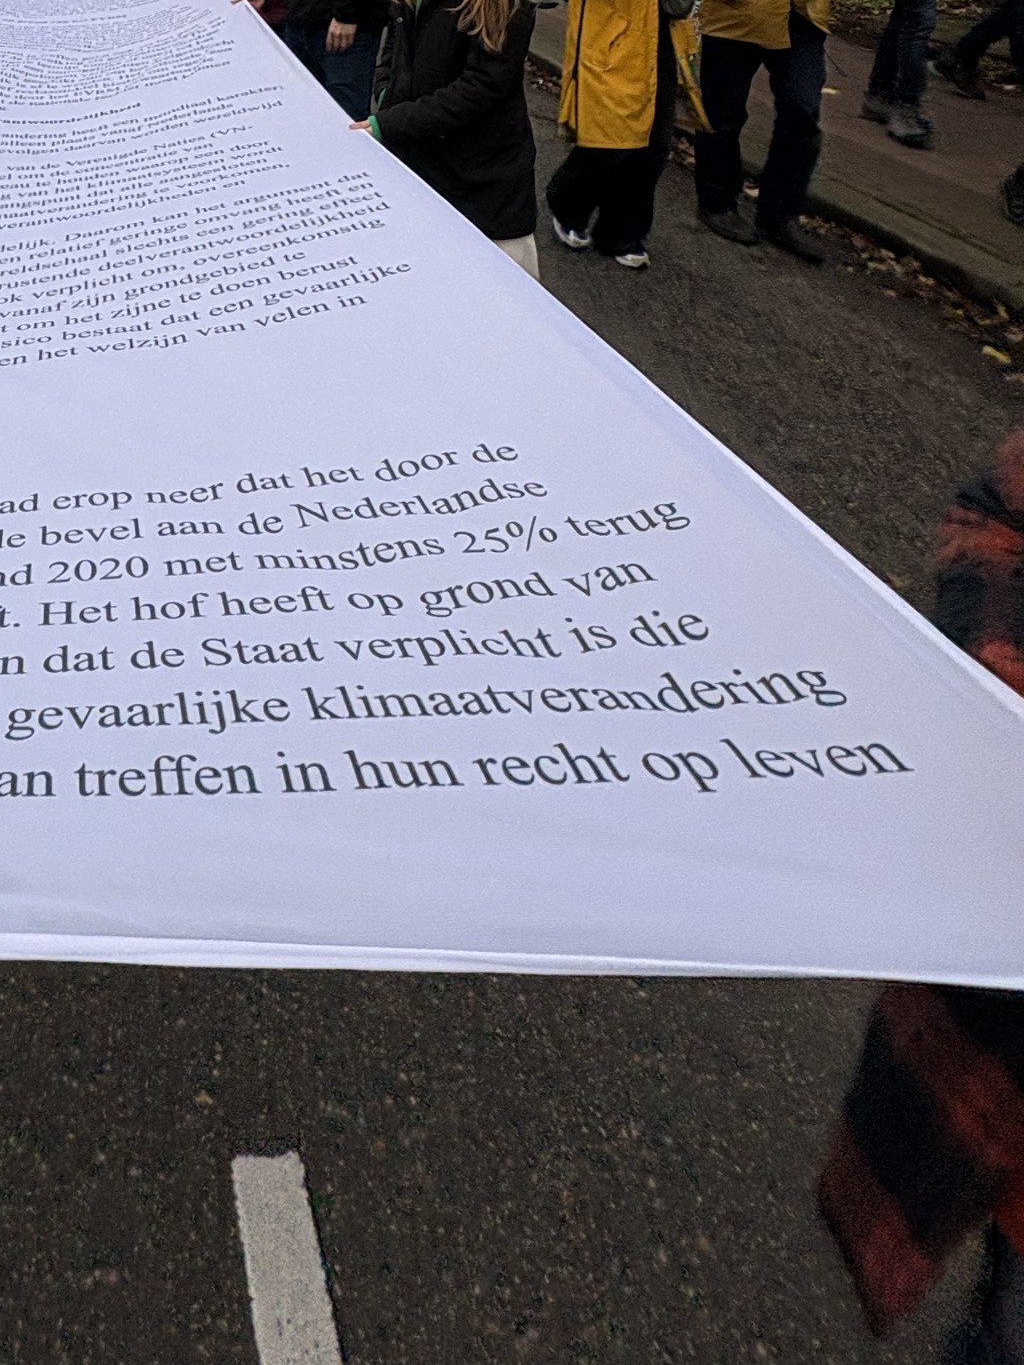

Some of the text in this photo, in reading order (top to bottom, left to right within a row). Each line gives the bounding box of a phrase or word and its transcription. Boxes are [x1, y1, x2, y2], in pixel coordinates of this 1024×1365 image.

[16, 320, 55, 331] om
[64, 310, 103, 326] het
[110, 299, 171, 319] zijne
[178, 291, 202, 304] te
[209, 276, 271, 296] doen
[275, 255, 359, 281] berust
[61, 320, 153, 341] bestaat
[160, 310, 201, 326] dat
[208, 298, 254, 317] een
[262, 263, 411, 306] gevaarlijke
[37, 346, 78, 361] het
[86, 333, 188, 353] welzijn
[195, 322, 246, 337] van
[253, 302, 331, 327] velen
[336, 295, 368, 308] in
[52, 491, 132, 511] erop
[143, 482, 224, 504] neer
[236, 472, 295, 494] dat
[299, 466, 365, 488] het
[374, 451, 459, 482] door
[471, 443, 519, 463] de
[39, 517, 143, 546] bevel
[156, 521, 226, 536] aan
[237, 511, 284, 535] de
[289, 478, 548, 529] Nederlandse
[47, 555, 149, 584] 2020
[162, 551, 244, 576] met
[253, 538, 445, 570] minstens
[453, 515, 558, 553] 25%
[563, 502, 691, 536] terug
[37, 600, 119, 626] Het
[129, 592, 209, 621] hof
[216, 585, 335, 616] heeft
[347, 592, 404, 616] op
[419, 571, 558, 618] grond
[560, 563, 658, 597] van
[43, 644, 116, 674] dat
[130, 640, 185, 670] de
[201, 636, 325, 667] Staat
[333, 627, 563, 667] verplicht
[568, 618, 617, 654] is
[629, 614, 709, 647] die
[4, 689, 291, 741] gevaarlijke
[301, 669, 847, 721] klimaatverandering
[74, 754, 262, 797] treffen
[275, 762, 337, 793] in
[342, 749, 465, 790] hun
[471, 742, 630, 786] recht
[641, 751, 719, 793] op
[719, 738, 915, 778] leven
